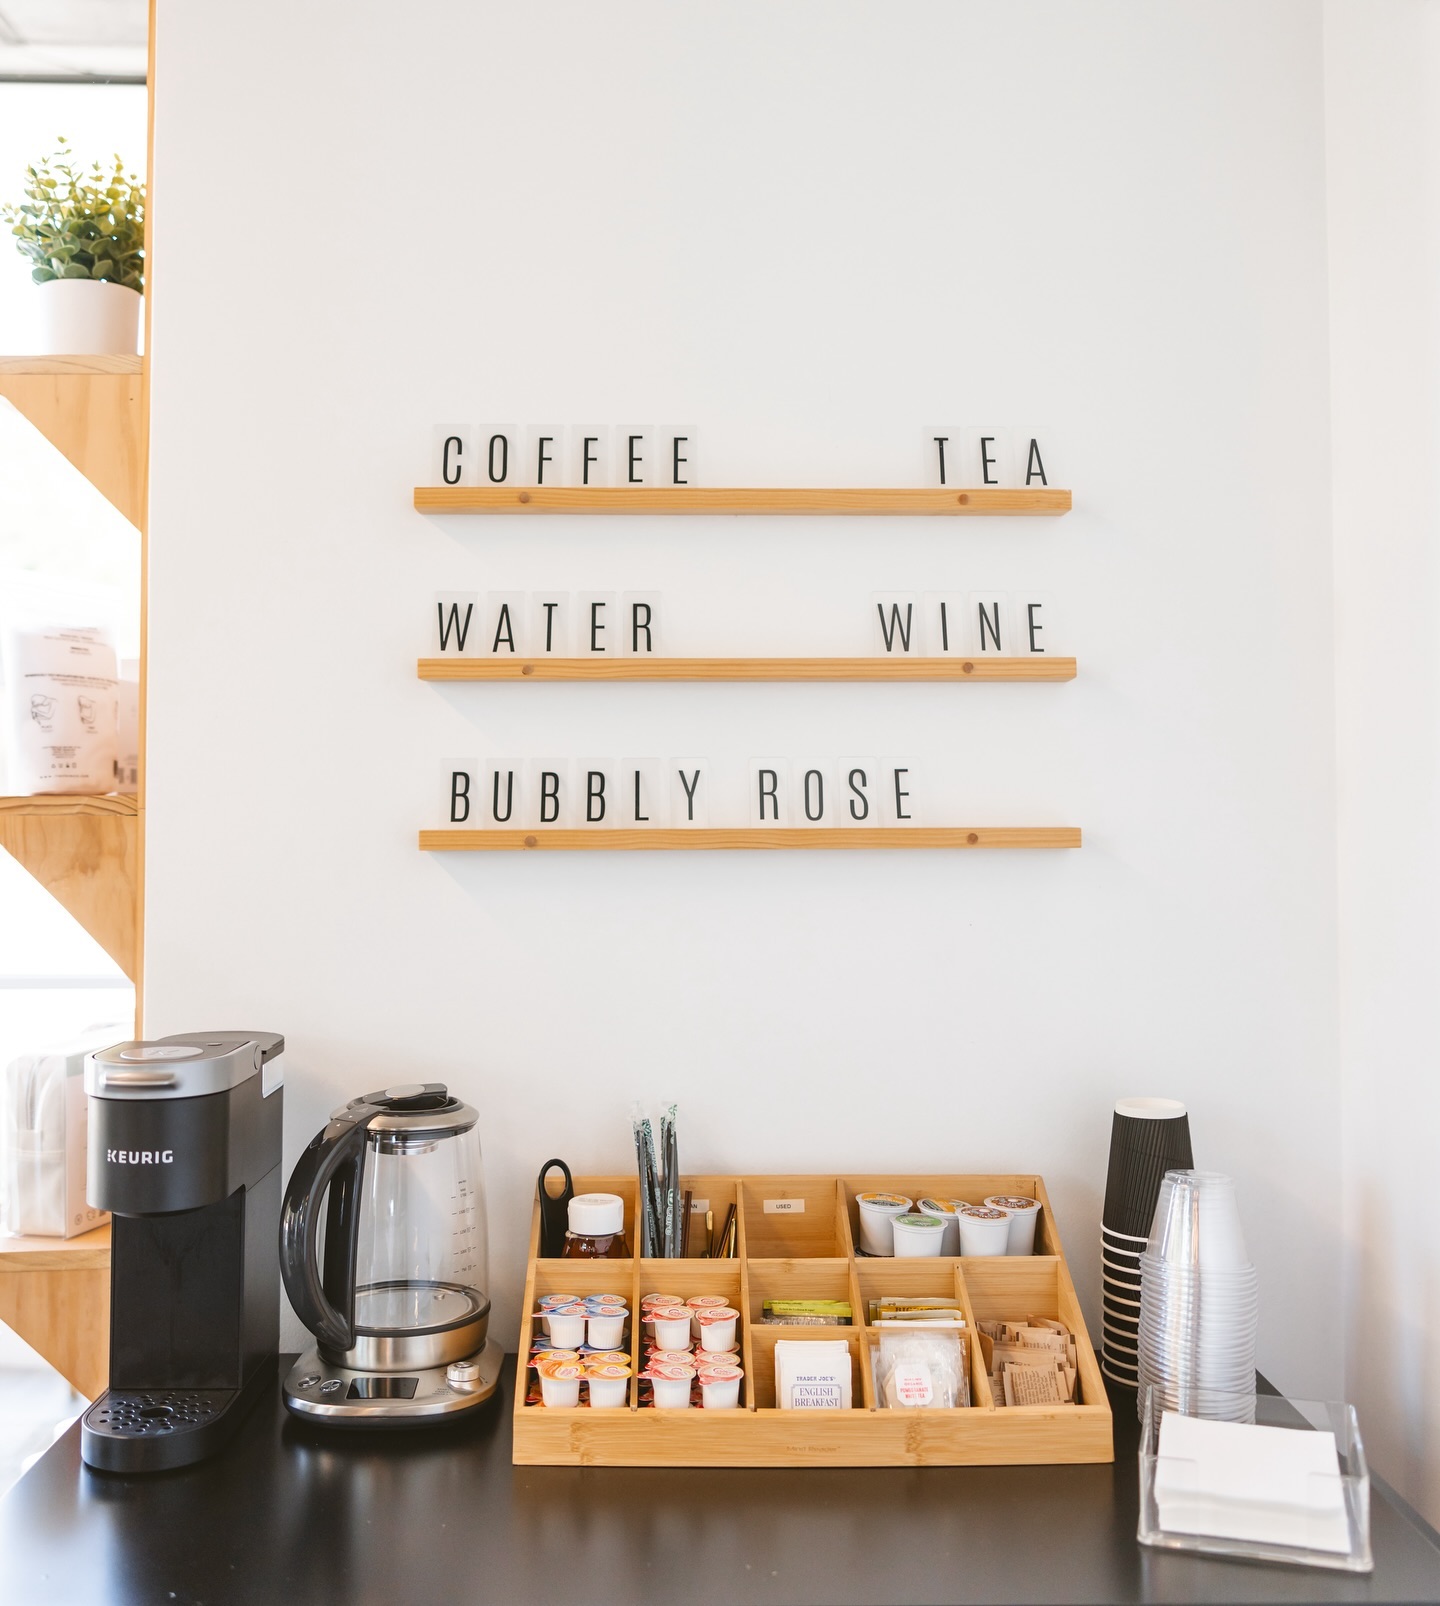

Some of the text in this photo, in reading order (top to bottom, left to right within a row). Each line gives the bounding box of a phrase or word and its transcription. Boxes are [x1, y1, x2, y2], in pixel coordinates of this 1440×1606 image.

[442, 435, 689, 485] COFFEE
[933, 437, 1048, 486] TEA
[437, 602, 652, 653] WATER
[877, 602, 1045, 653] WINE
[450, 768, 912, 823] BUBBLY ROSE
[107, 1149, 173, 1164] KEURIG
[794, 1397, 839, 1407] BREAKFAST
[799, 1387, 833, 1396] ENGLISH
